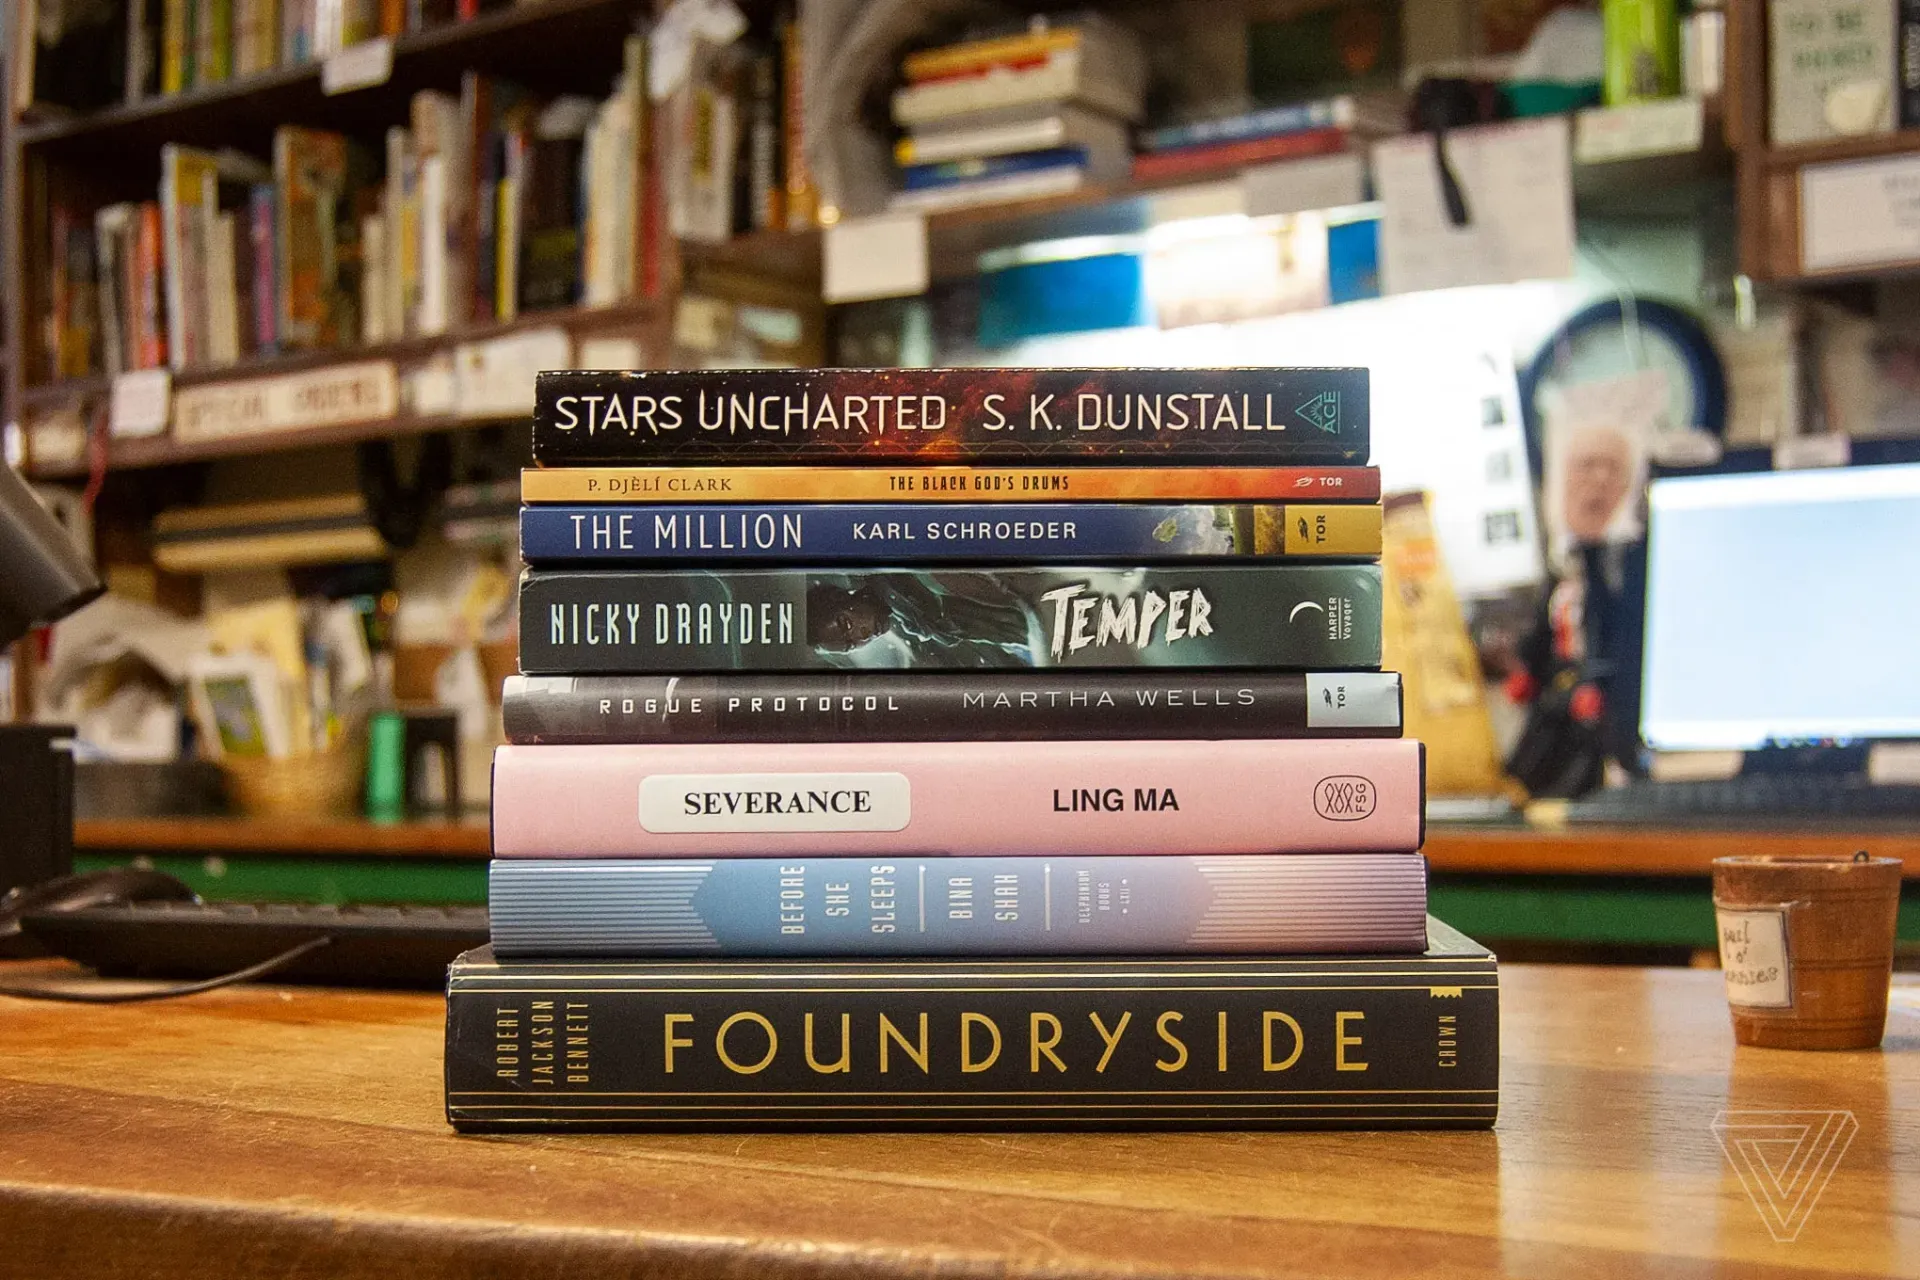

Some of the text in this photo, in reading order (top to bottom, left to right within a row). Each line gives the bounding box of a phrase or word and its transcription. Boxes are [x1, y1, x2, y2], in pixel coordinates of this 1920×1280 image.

[554, 389, 1286, 436] STARS UNCHARTED S. K. DUNSTALL
[1323, 391, 1337, 434] ACE
[588, 478, 601, 492] P.
[668, 478, 732, 492] CLARK
[889, 476, 914, 491] THE
[923, 475, 966, 491] BLACK
[975, 475, 1015, 491] GOD'S
[1023, 475, 1069, 491] DRUMS
[1319, 477, 1343, 487] TOR
[570, 513, 1077, 549] THE MILLION KARL SCHROEDER
[1316, 514, 1326, 543] TOR
[551, 583, 1214, 664] NICKY DRAYDEN TEMPER
[1329, 597, 1337, 640] HARPER
[1343, 598, 1353, 640] Voyager
[600, 688, 1256, 714] ROGUE PROTOCOL MARTHA WELLS
[1337, 685, 1346, 709] TOR
[684, 788, 1179, 816] SEVERANCE LING MA
[1355, 783, 1366, 813] FSG
[781, 864, 805, 934] BEFORE
[825, 881, 850, 917] SHE
[872, 864, 896, 933] SLEEPS
[949, 876, 973, 919] BINA
[995, 874, 1018, 921] SHAH
[496, 1008, 519, 1077] ROBERT
[532, 1001, 554, 1084] JACKSON
[567, 1002, 589, 1082] BENNETT
[664, 1011, 1369, 1076] FOUNDRYSIDE
[1438, 1015, 1457, 1067] CROWN
